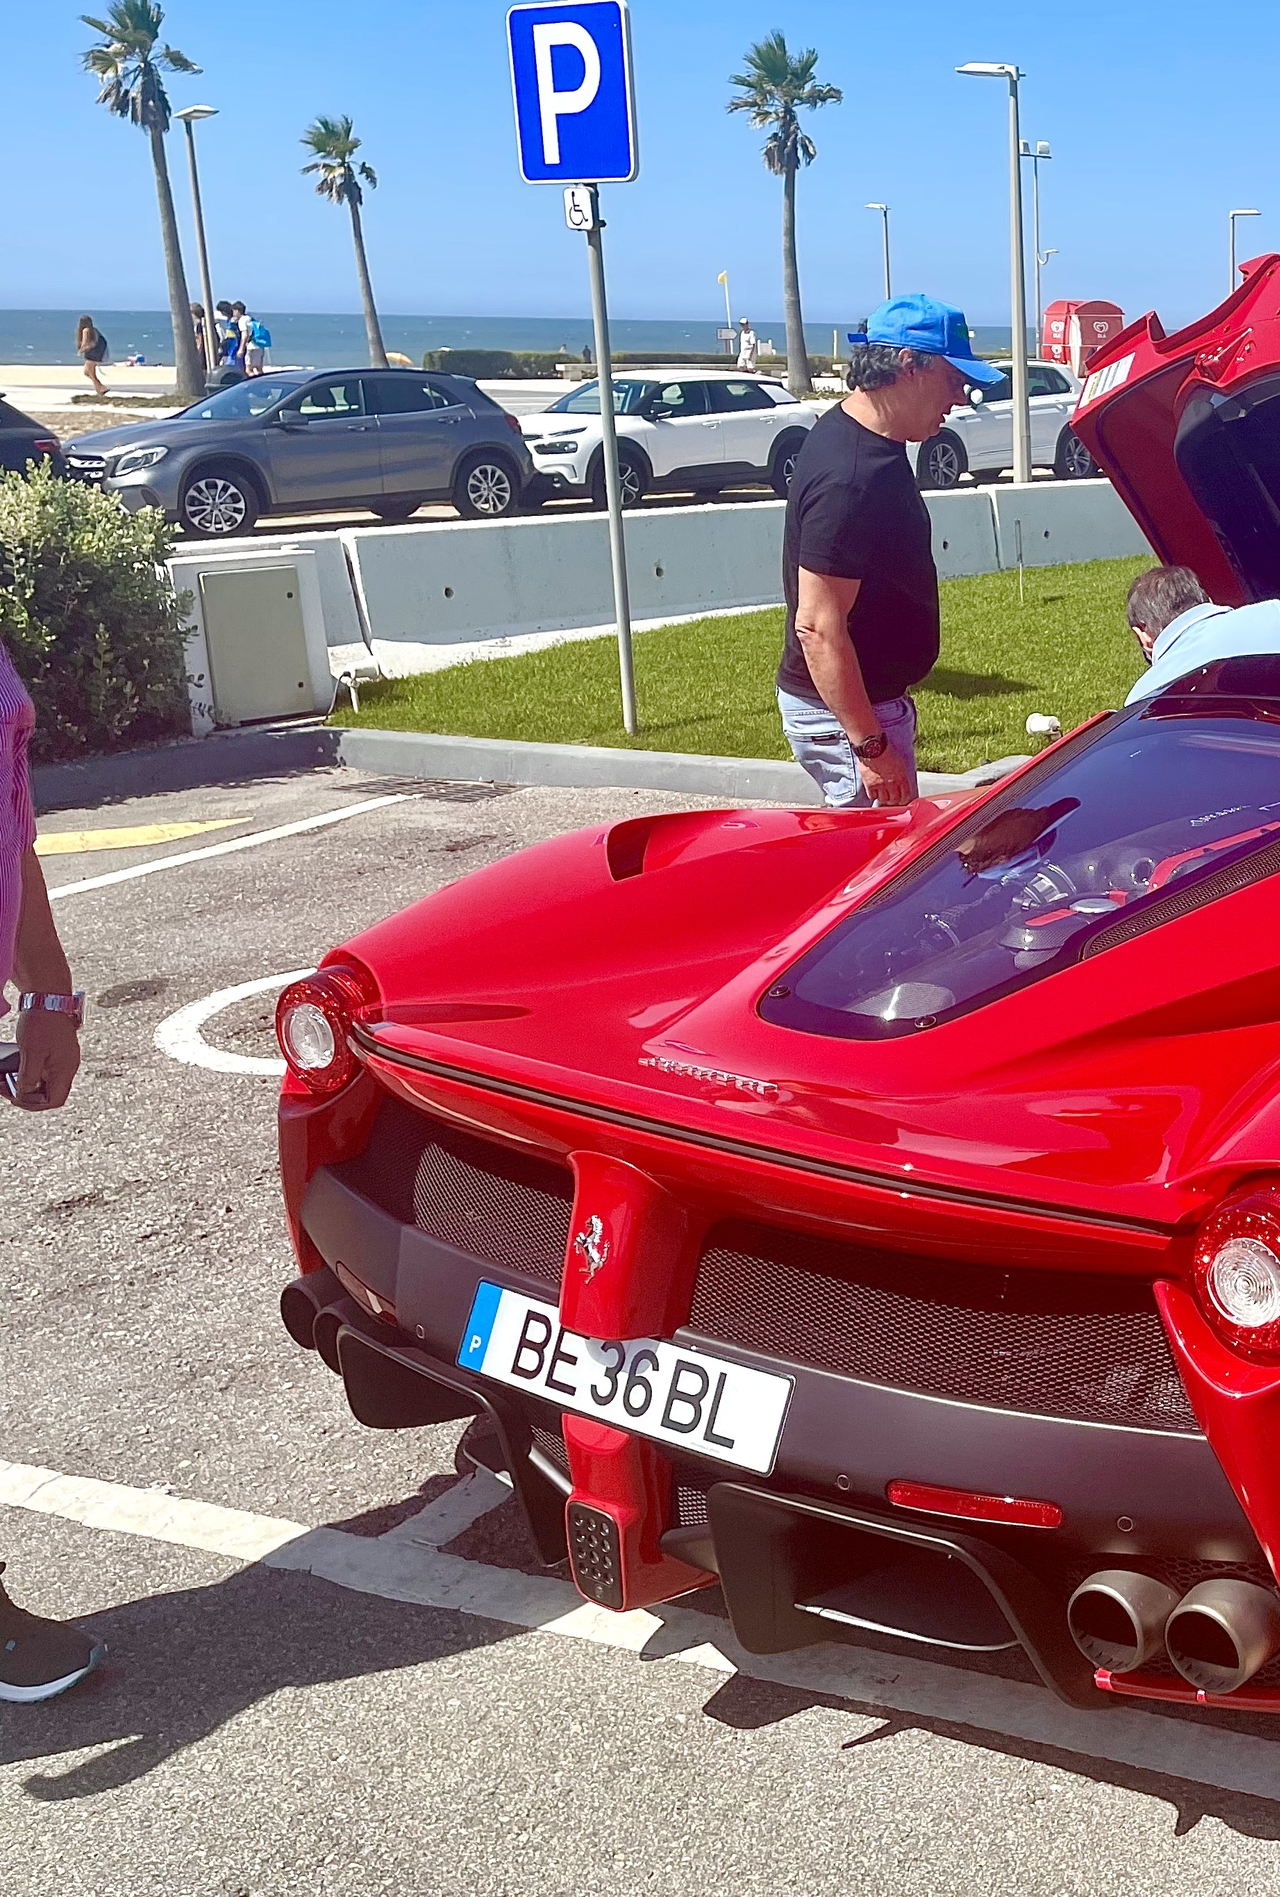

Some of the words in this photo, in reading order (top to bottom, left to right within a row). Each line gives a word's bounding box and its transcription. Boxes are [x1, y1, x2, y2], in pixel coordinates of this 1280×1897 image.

[533, 21, 601, 165] P
[469, 1334, 482, 1353] P
[510, 1309, 590, 1397] BE
[590, 1341, 660, 1417] 36
[660, 1359, 735, 1449] BL
